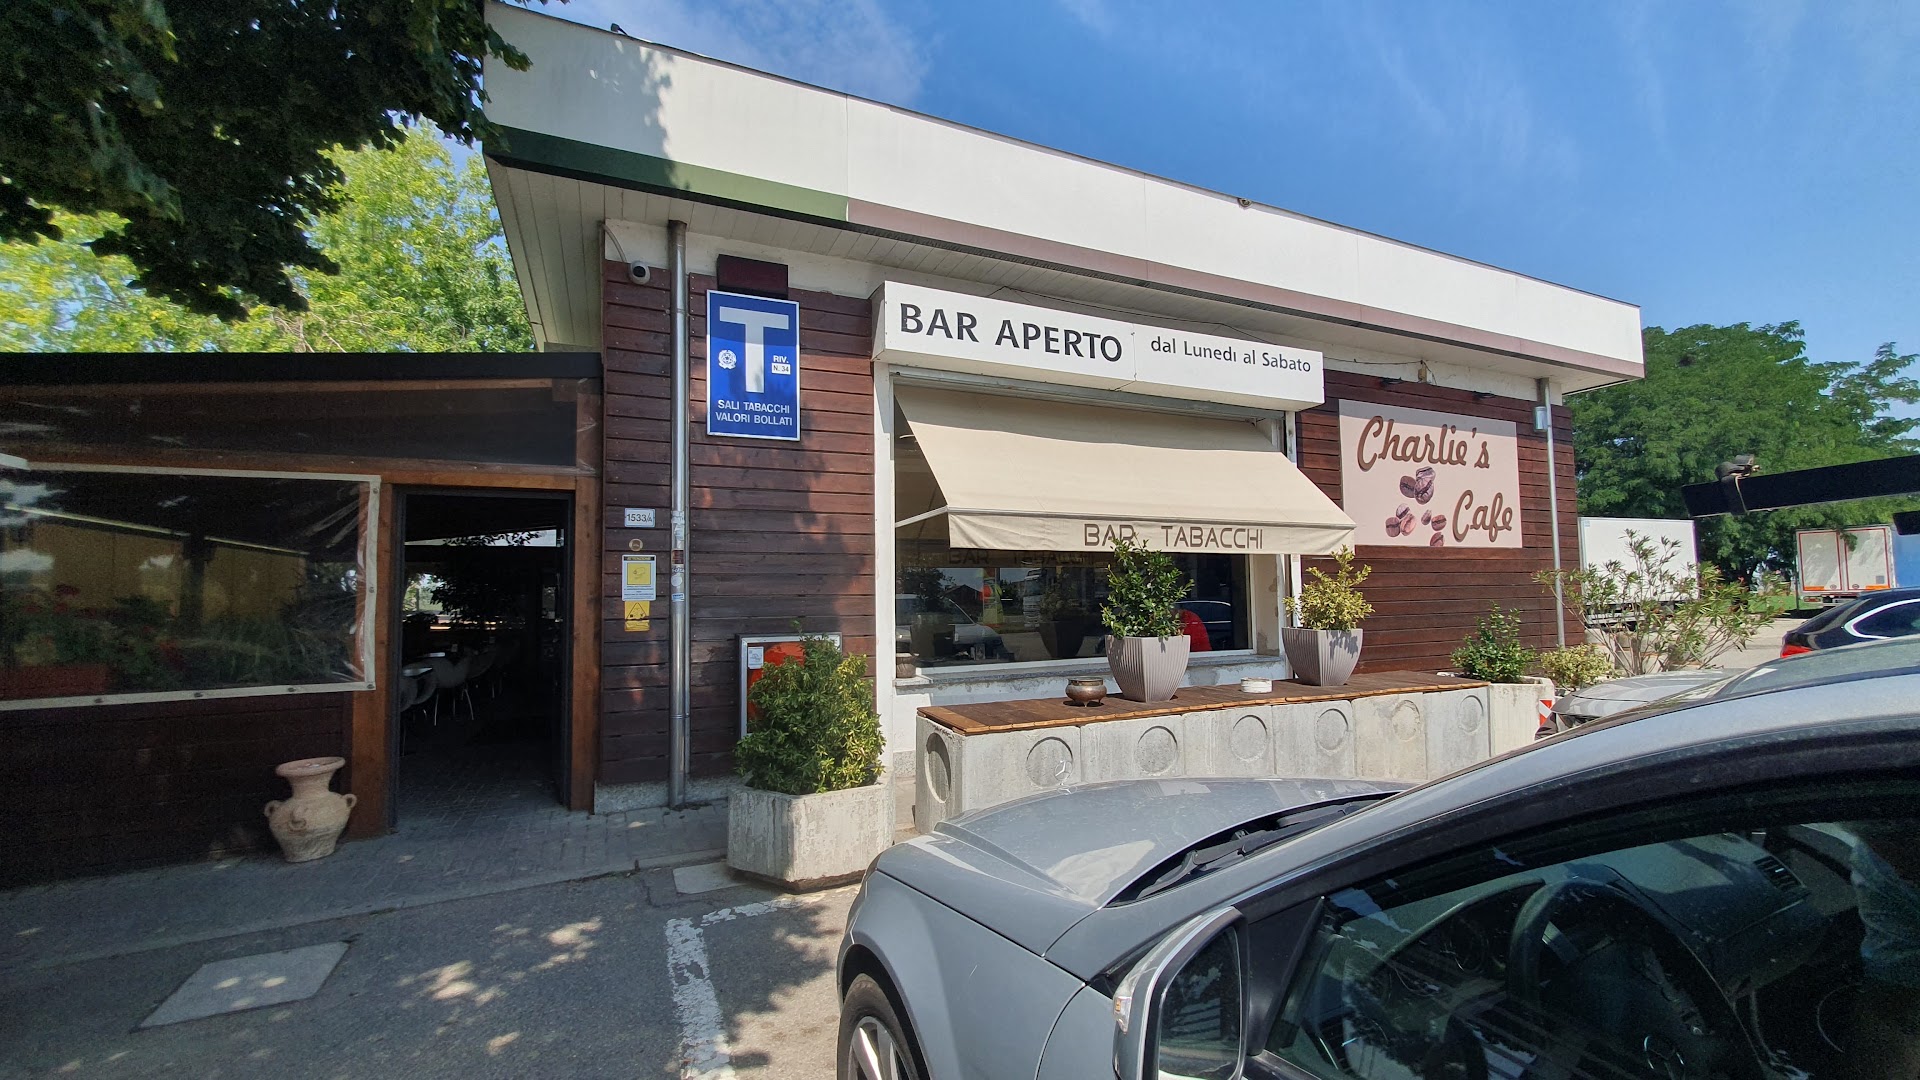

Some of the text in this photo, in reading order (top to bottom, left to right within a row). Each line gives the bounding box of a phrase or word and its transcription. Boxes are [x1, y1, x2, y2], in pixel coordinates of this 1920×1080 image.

[719, 306, 789, 393] T
[900, 303, 1122, 362] BAR APERTO
[773, 355, 789, 364] RIV.
[1151, 336, 1176, 354] dal
[1243, 350, 1255, 365] al
[1262, 352, 1311, 373] Sabato
[715, 412, 793, 426] VALORI BOLLATI
[717, 400, 790, 414] SALI TABACCHI
[1357, 415, 1490, 472] Charlie's
[1452, 489, 1513, 543] Cafe
[1084, 523, 1263, 549] BAR TABACCHI
